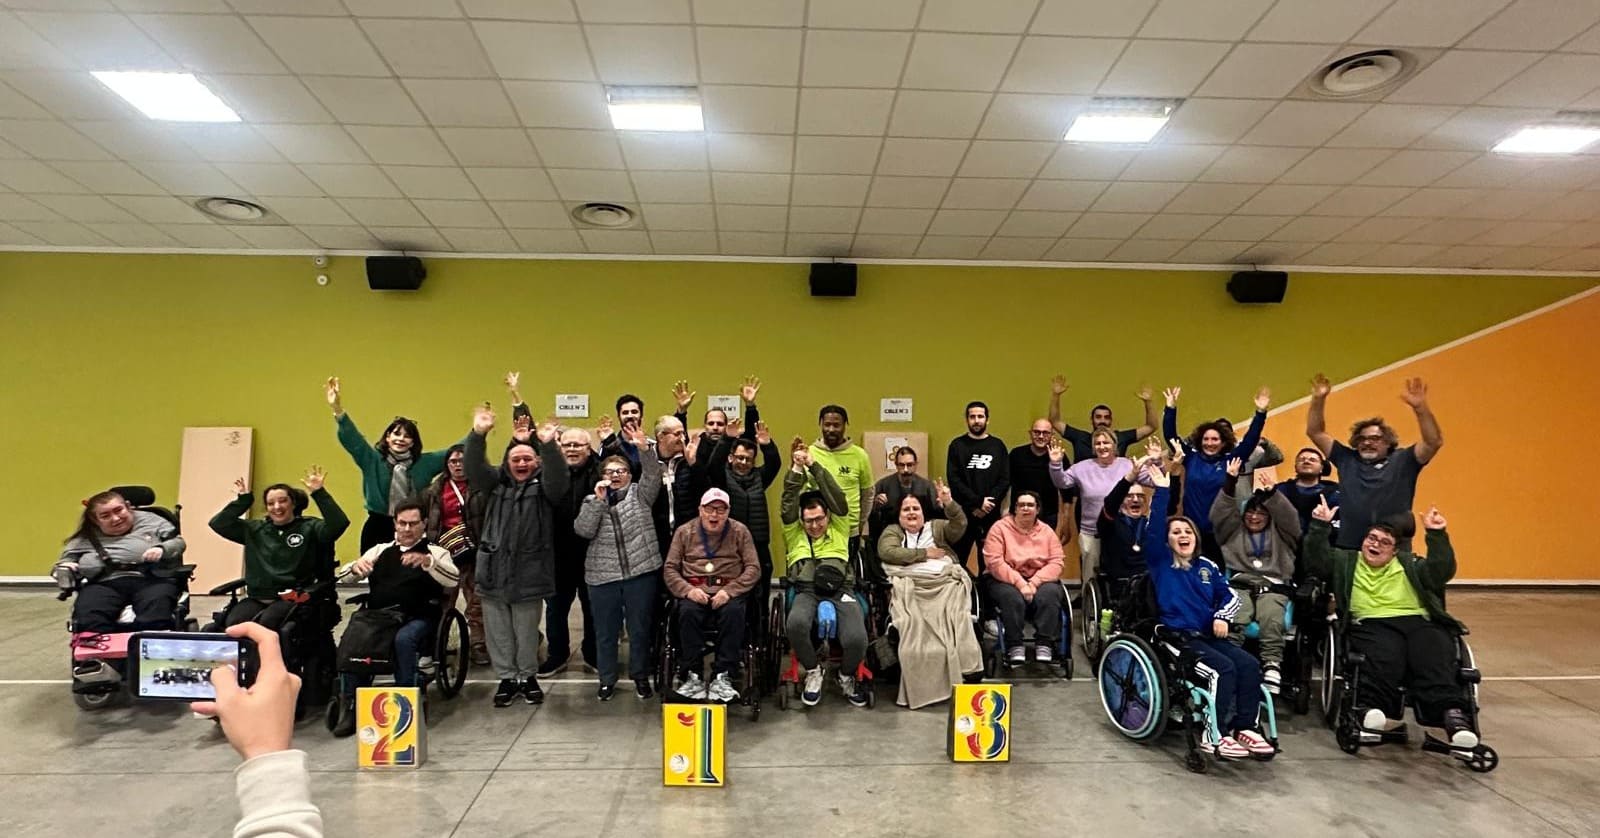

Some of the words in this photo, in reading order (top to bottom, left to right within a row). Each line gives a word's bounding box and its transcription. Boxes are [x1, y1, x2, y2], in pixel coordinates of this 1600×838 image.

[371, 692, 415, 766] 2
[677, 707, 720, 784] 1
[967, 690, 1007, 759] 3
